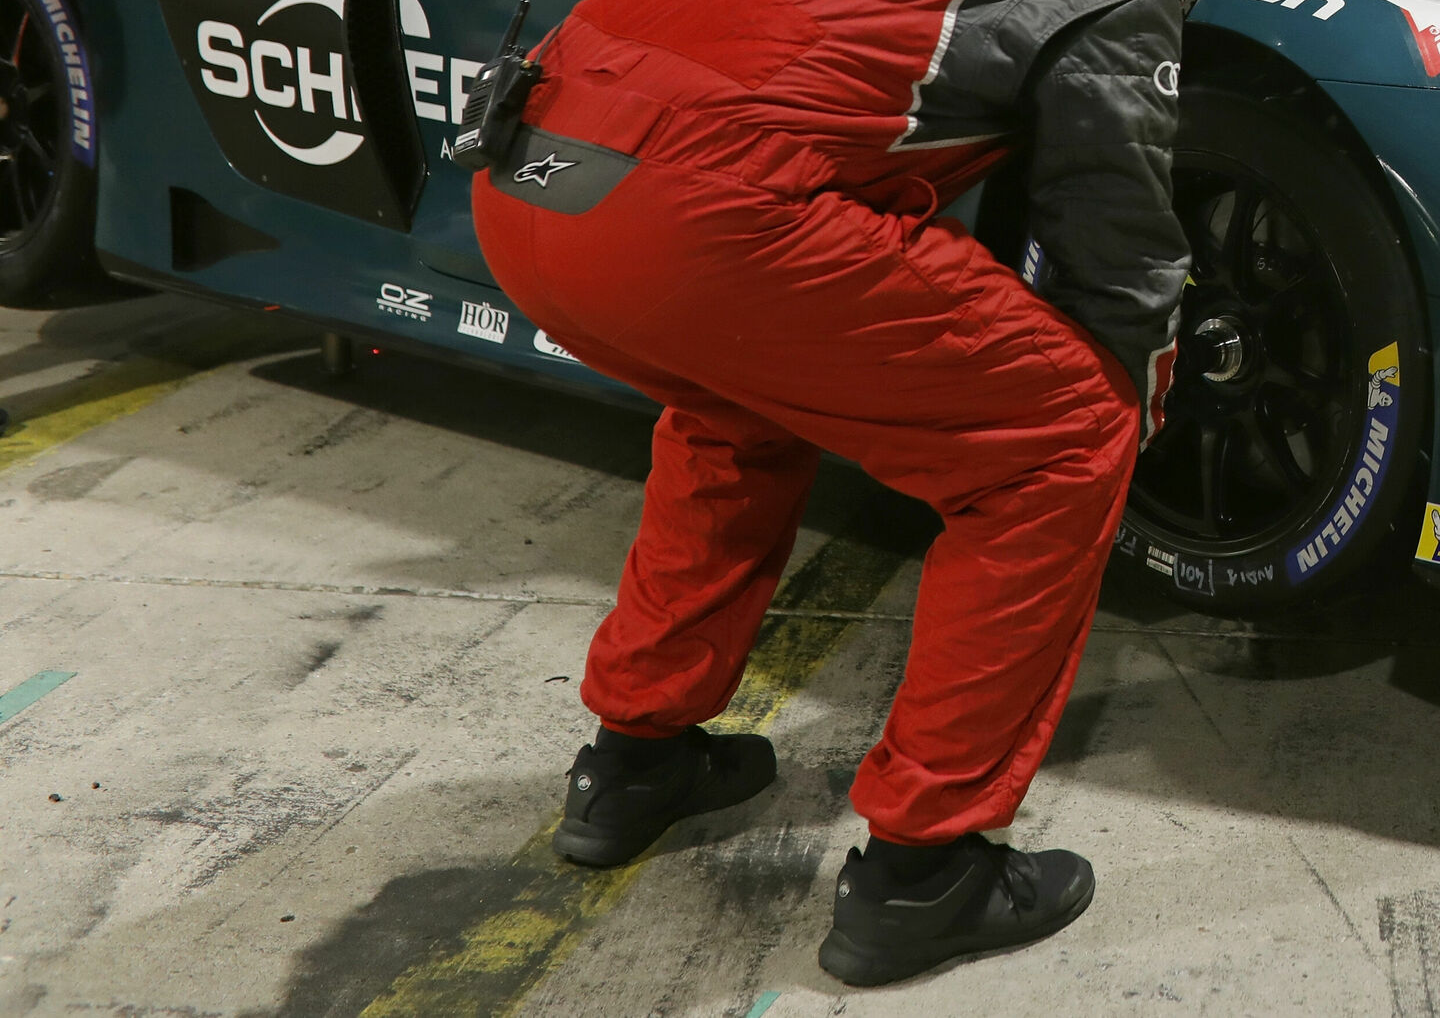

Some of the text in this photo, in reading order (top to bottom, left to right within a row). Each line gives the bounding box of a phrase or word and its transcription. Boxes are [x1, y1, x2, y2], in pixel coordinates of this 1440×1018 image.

[197, 19, 486, 126] SCHE
[378, 305, 428, 322] RACING
[463, 299, 507, 335] HÖR
[1295, 416, 1390, 574] MICHELIN
